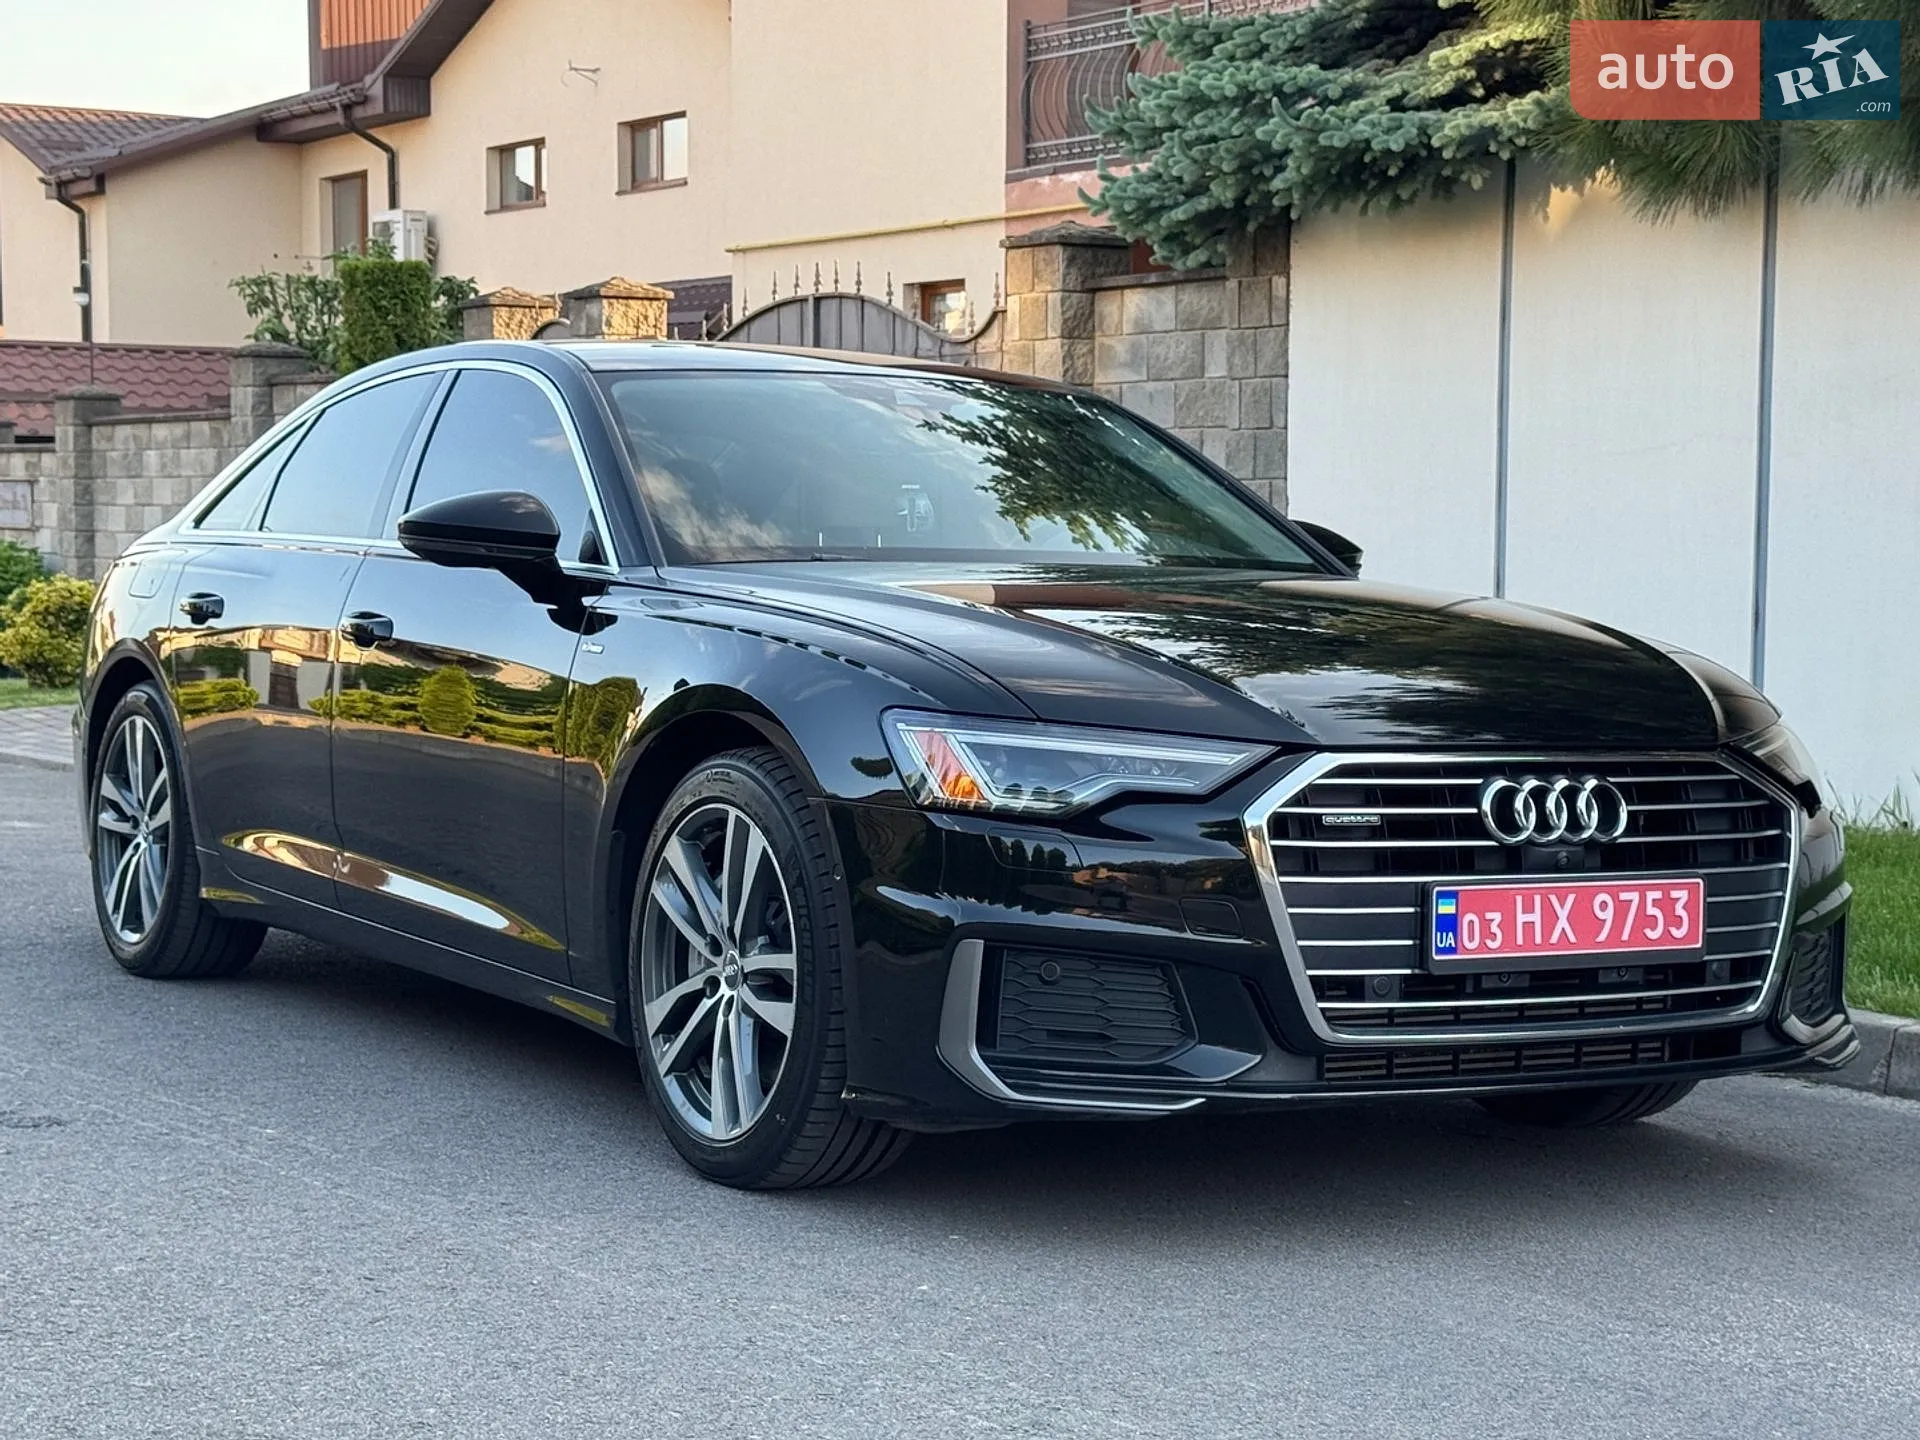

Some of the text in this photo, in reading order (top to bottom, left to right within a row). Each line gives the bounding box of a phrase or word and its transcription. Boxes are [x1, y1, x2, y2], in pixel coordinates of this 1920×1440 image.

[1461, 889, 1690, 950] 03 HX 9753
[1436, 932, 1456, 948] UA
